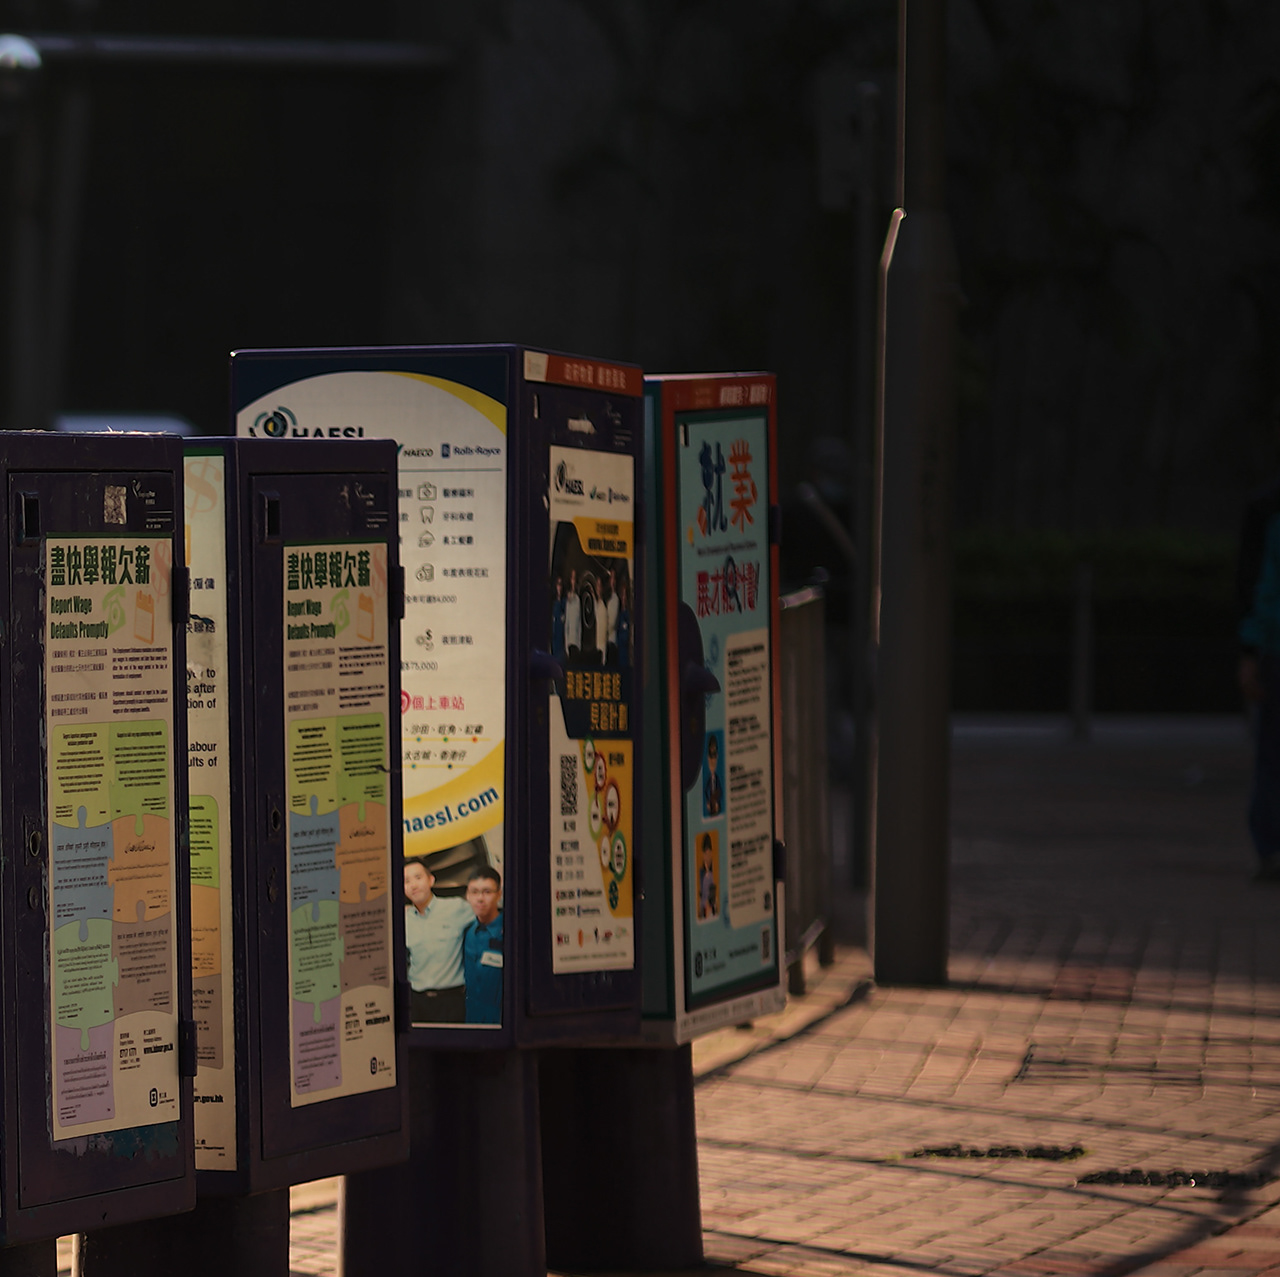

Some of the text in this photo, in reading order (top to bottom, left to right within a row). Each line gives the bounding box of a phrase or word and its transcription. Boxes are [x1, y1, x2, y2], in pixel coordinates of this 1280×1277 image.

[51, 545, 150, 585] 盡快舉報欠薪
[288, 551, 370, 590] 盡快舉報欠薪
[51, 596, 92, 614] Report Wage
[207, 668, 216, 677] to
[194, 684, 216, 695] after
[207, 699, 216, 708] of
[412, 696, 464, 710] 個上車站
[208, 757, 217, 766] of
